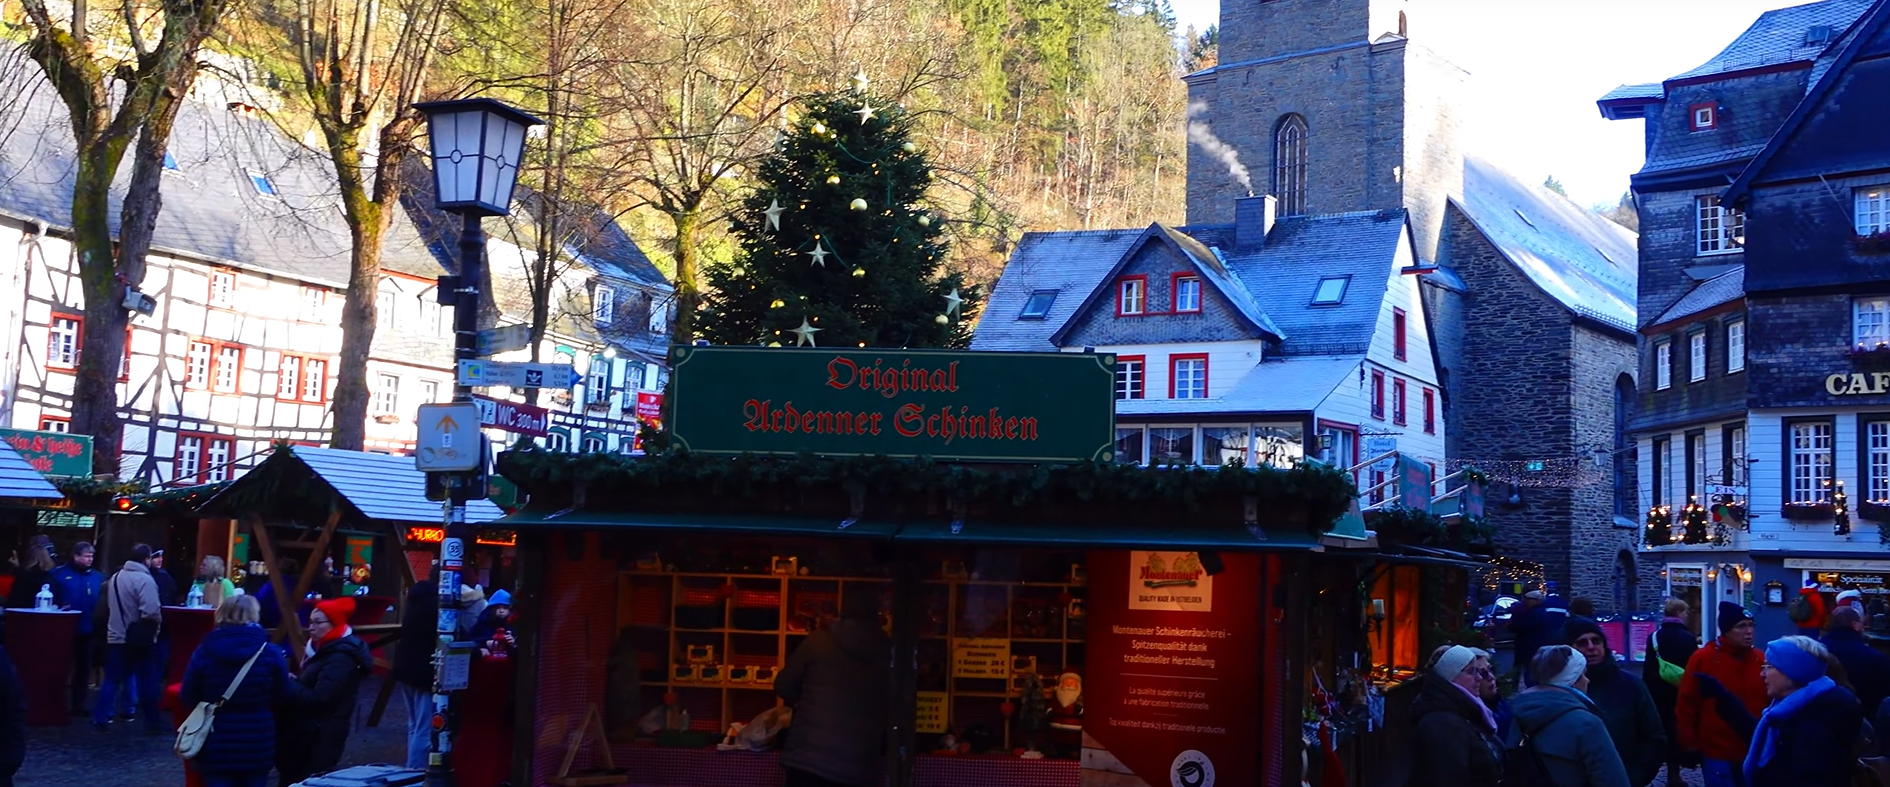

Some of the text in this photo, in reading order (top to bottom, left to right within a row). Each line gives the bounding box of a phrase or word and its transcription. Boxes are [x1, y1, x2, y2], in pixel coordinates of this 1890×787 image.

[826, 355, 960, 399] Original
[498, 404, 517, 427] WC
[742, 398, 1040, 446] Ardenner Schinken
[31, 435, 47, 453] &
[1715, 486, 1736, 494] EIS
[450, 544, 460, 553] 35
[1139, 567, 1203, 580] Montenauer
[1138, 594, 1156, 602] QUALITY
[1175, 595, 1202, 603] OSTBELGIEN
[1112, 624, 1155, 635] Montenauer
[1155, 626, 1226, 638] Schinkenräucherei
[1131, 639, 1208, 651] Spitzenqualität dank
[1124, 654, 1215, 668] traditioneller Herstellung
[1129, 686, 1137, 695] La
[1136, 686, 1157, 696] qualité
[1187, 690, 1206, 699] grâce
[1128, 698, 1138, 706] une
[1138, 697, 1170, 708] fabrication
[1109, 717, 1118, 726] Top
[1117, 718, 1142, 728] kwaliteit
[1141, 720, 1162, 731] dankzij
[1161, 723, 1197, 733] traditionele
